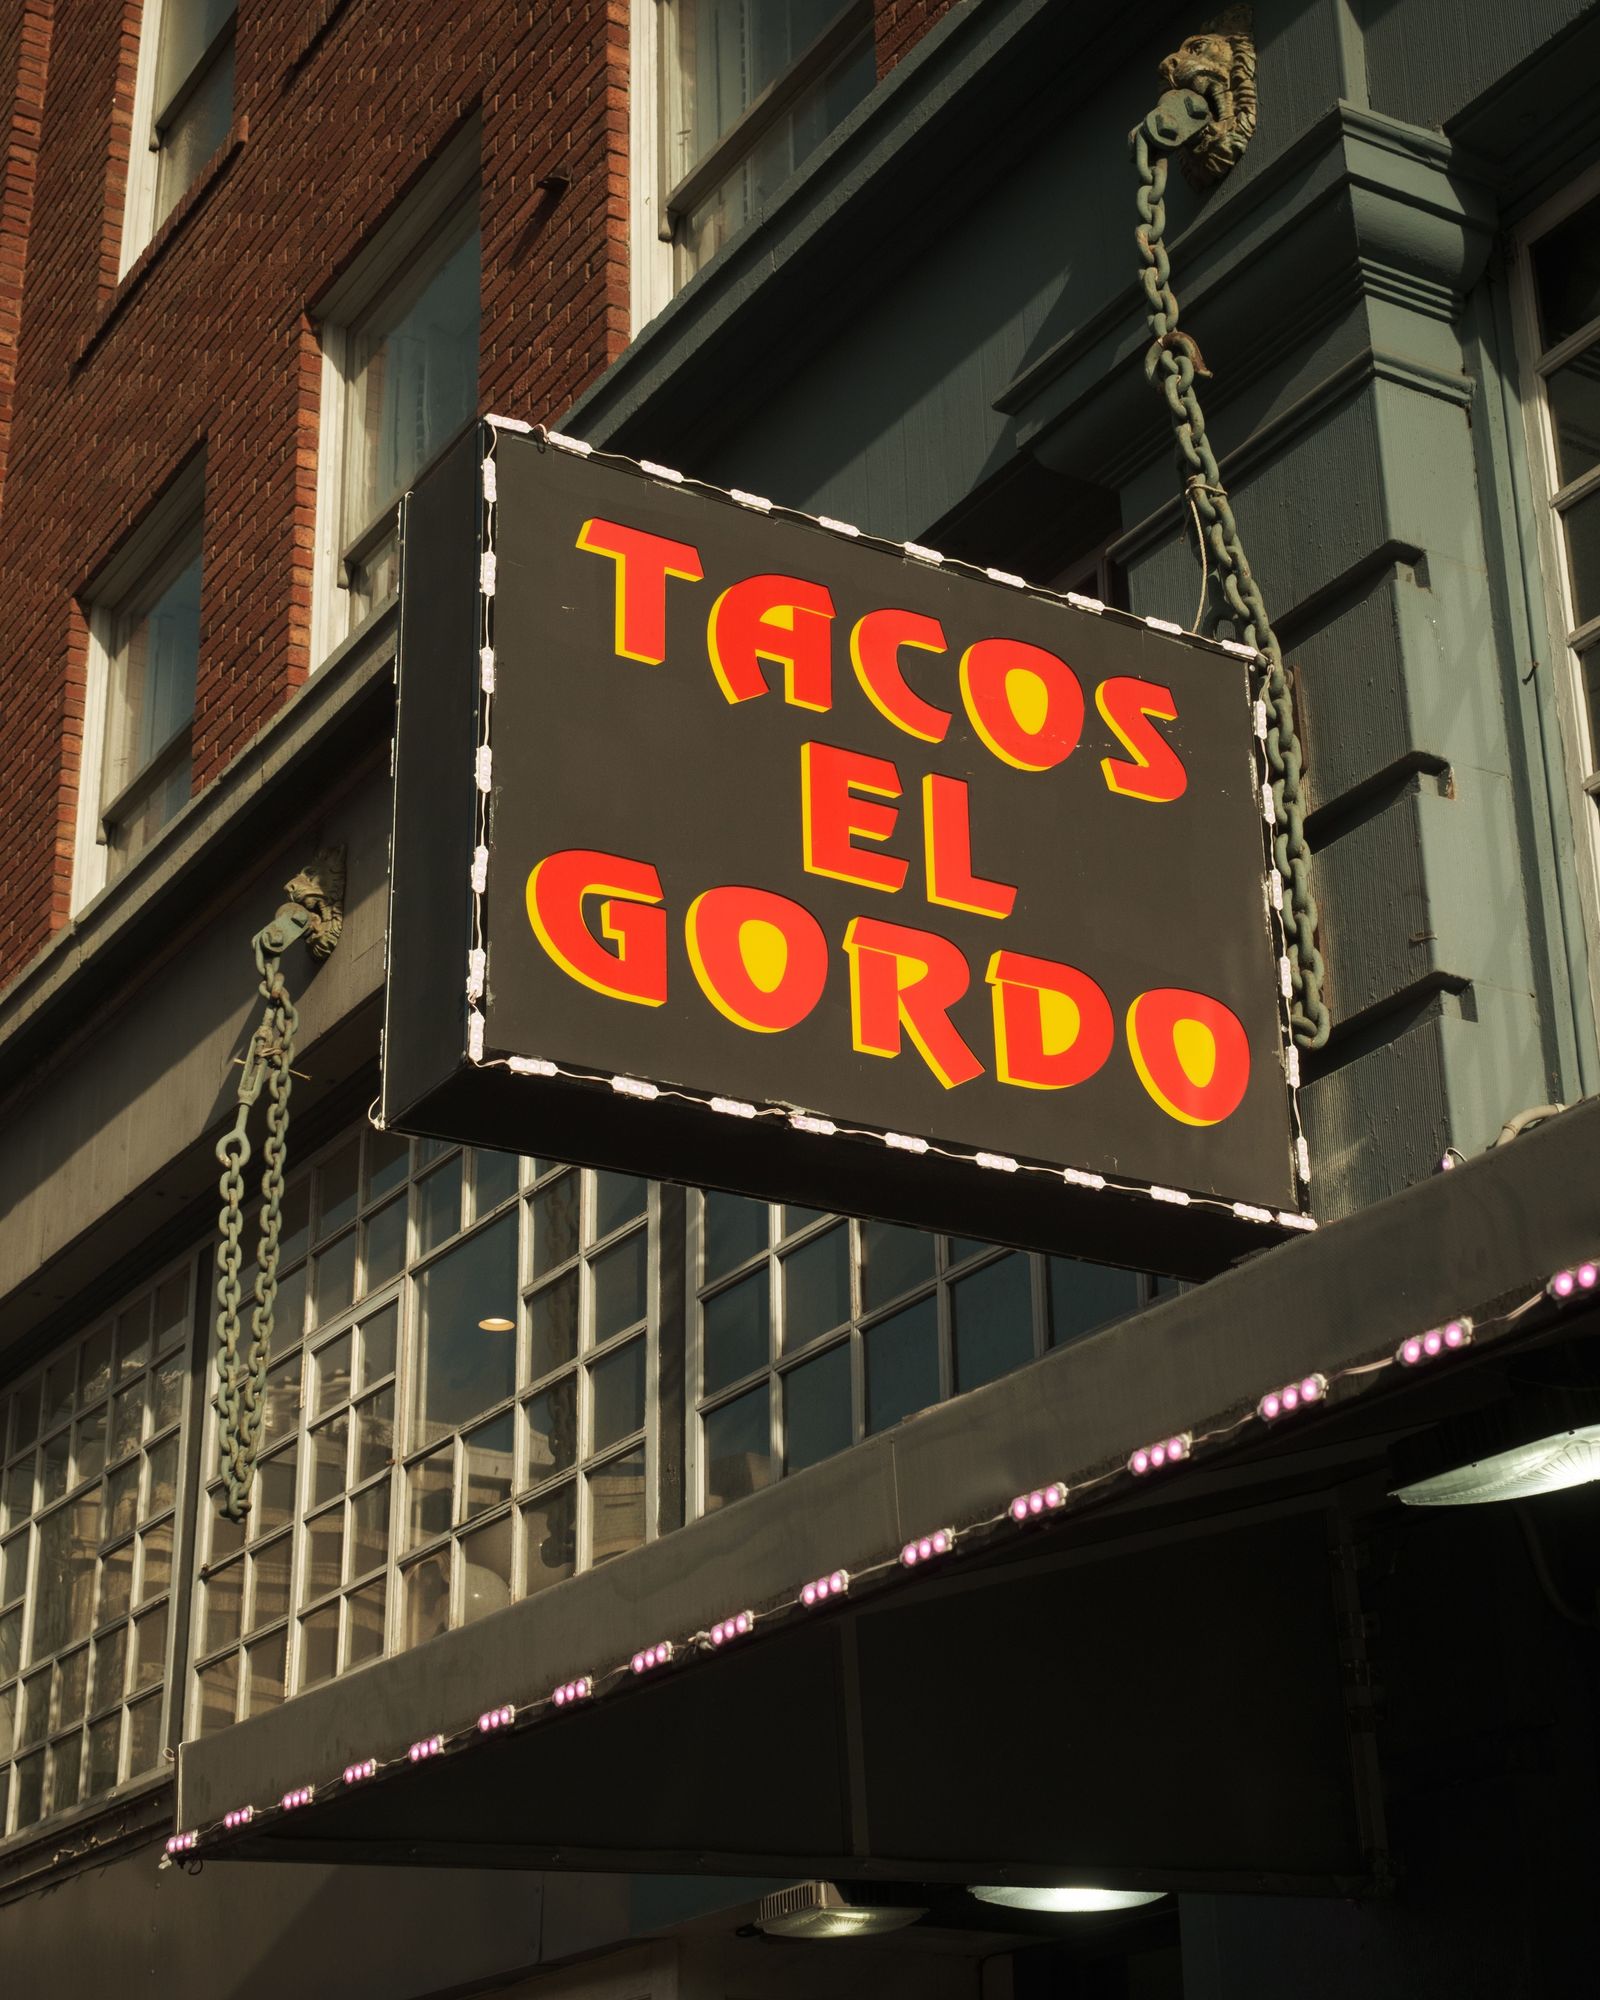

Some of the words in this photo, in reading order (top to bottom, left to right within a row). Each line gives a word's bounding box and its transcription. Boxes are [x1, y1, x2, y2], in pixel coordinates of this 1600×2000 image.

[575, 517, 1187, 803] TACOS
[800, 741, 1018, 920] EL
[525, 849, 1251, 1127] GORDO
